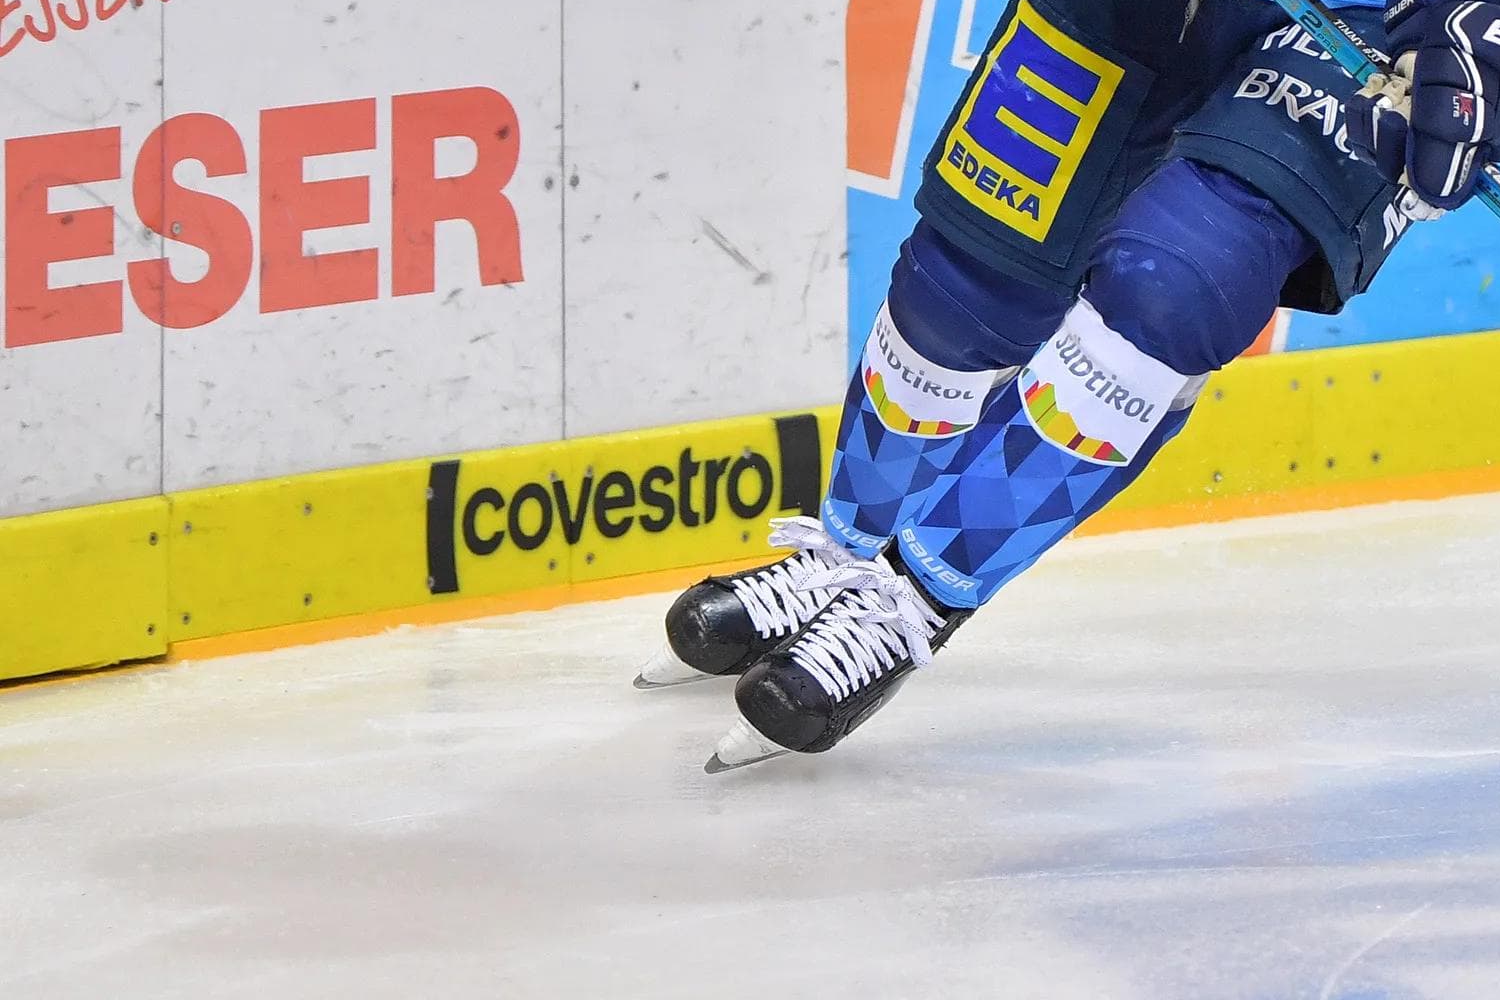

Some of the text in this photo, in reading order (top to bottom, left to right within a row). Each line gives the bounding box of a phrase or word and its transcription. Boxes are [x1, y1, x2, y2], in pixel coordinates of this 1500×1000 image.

[3, 85, 525, 349] ESER
[947, 146, 1041, 221] EDEKA
[461, 448, 775, 557] covestro
[900, 528, 975, 592] BAUER
